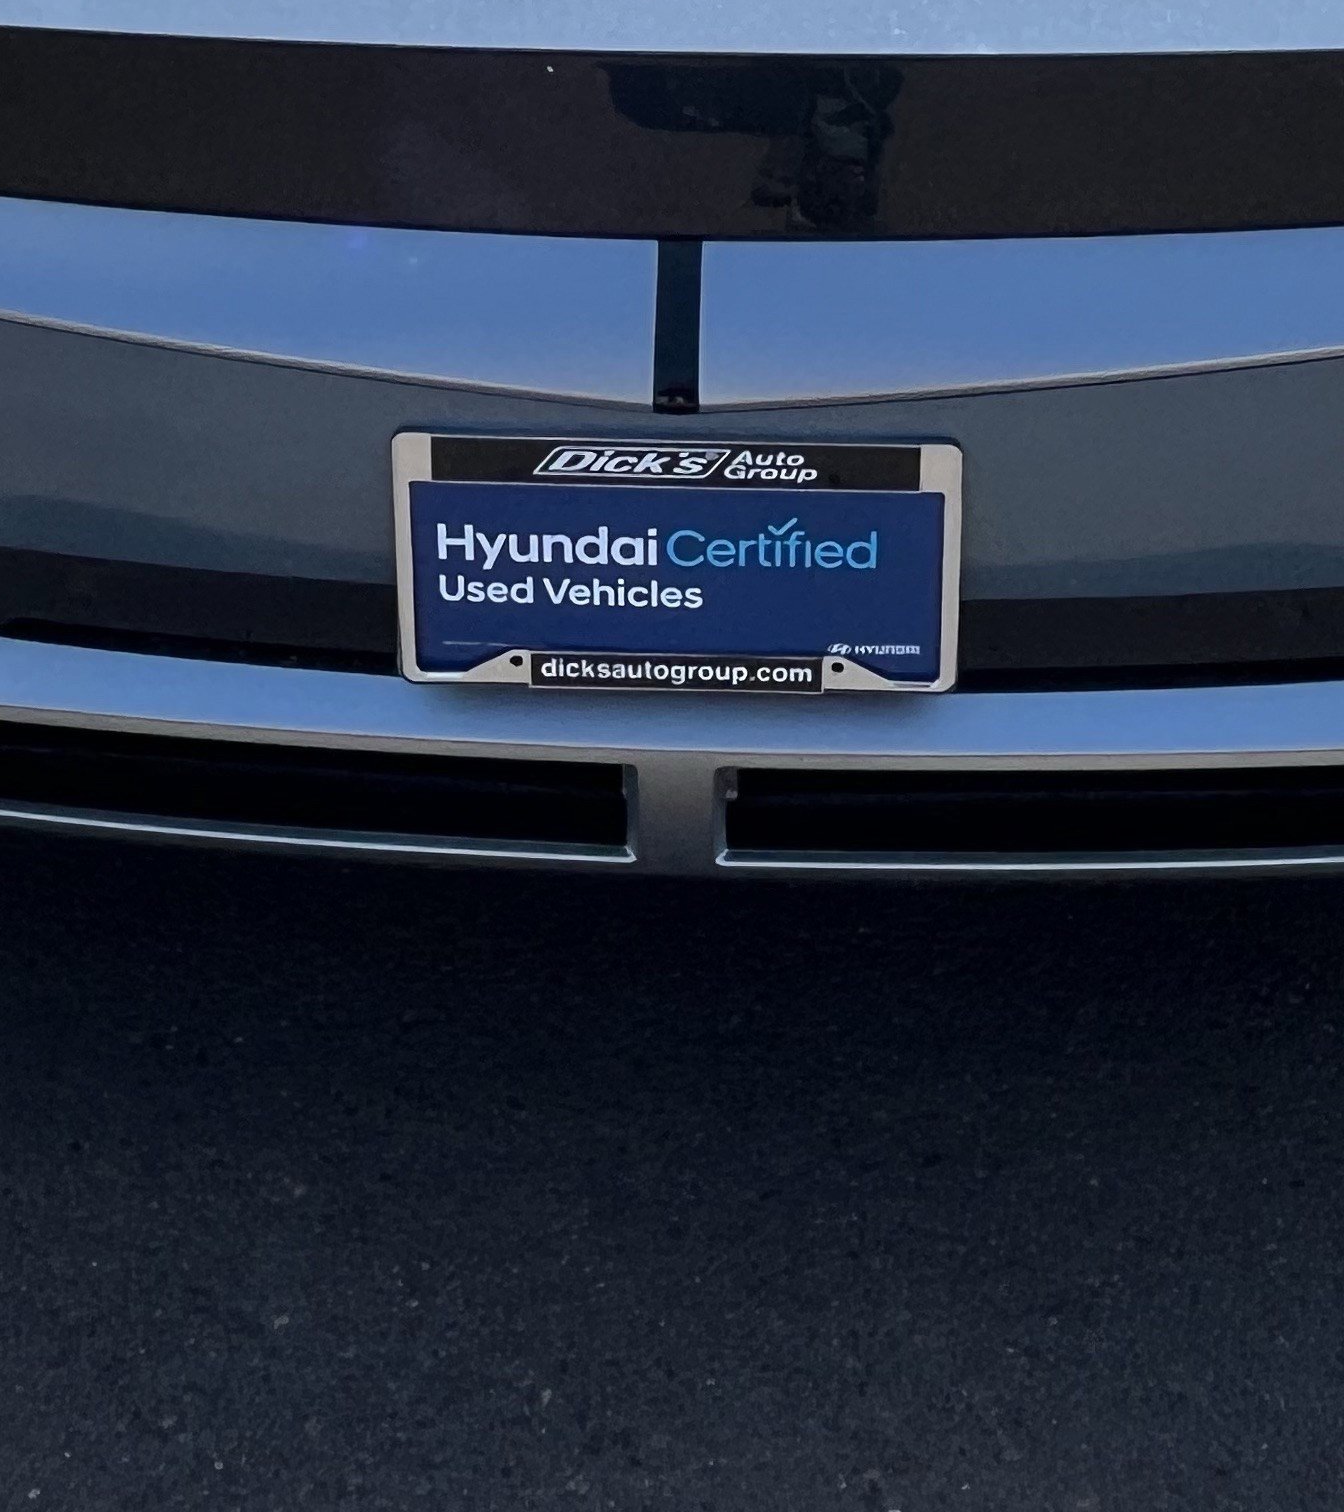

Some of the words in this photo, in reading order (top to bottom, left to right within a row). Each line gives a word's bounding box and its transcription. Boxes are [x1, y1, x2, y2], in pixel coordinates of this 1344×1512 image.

[548, 449, 707, 474] Dick's
[731, 450, 805, 467] Auto
[723, 464, 818, 484] Group
[436, 522, 658, 570] Hyundai
[666, 517, 878, 569] Certified
[438, 573, 534, 605] Used
[542, 577, 703, 609] Vehicles
[540, 657, 813, 686] dicksautogroup.com
